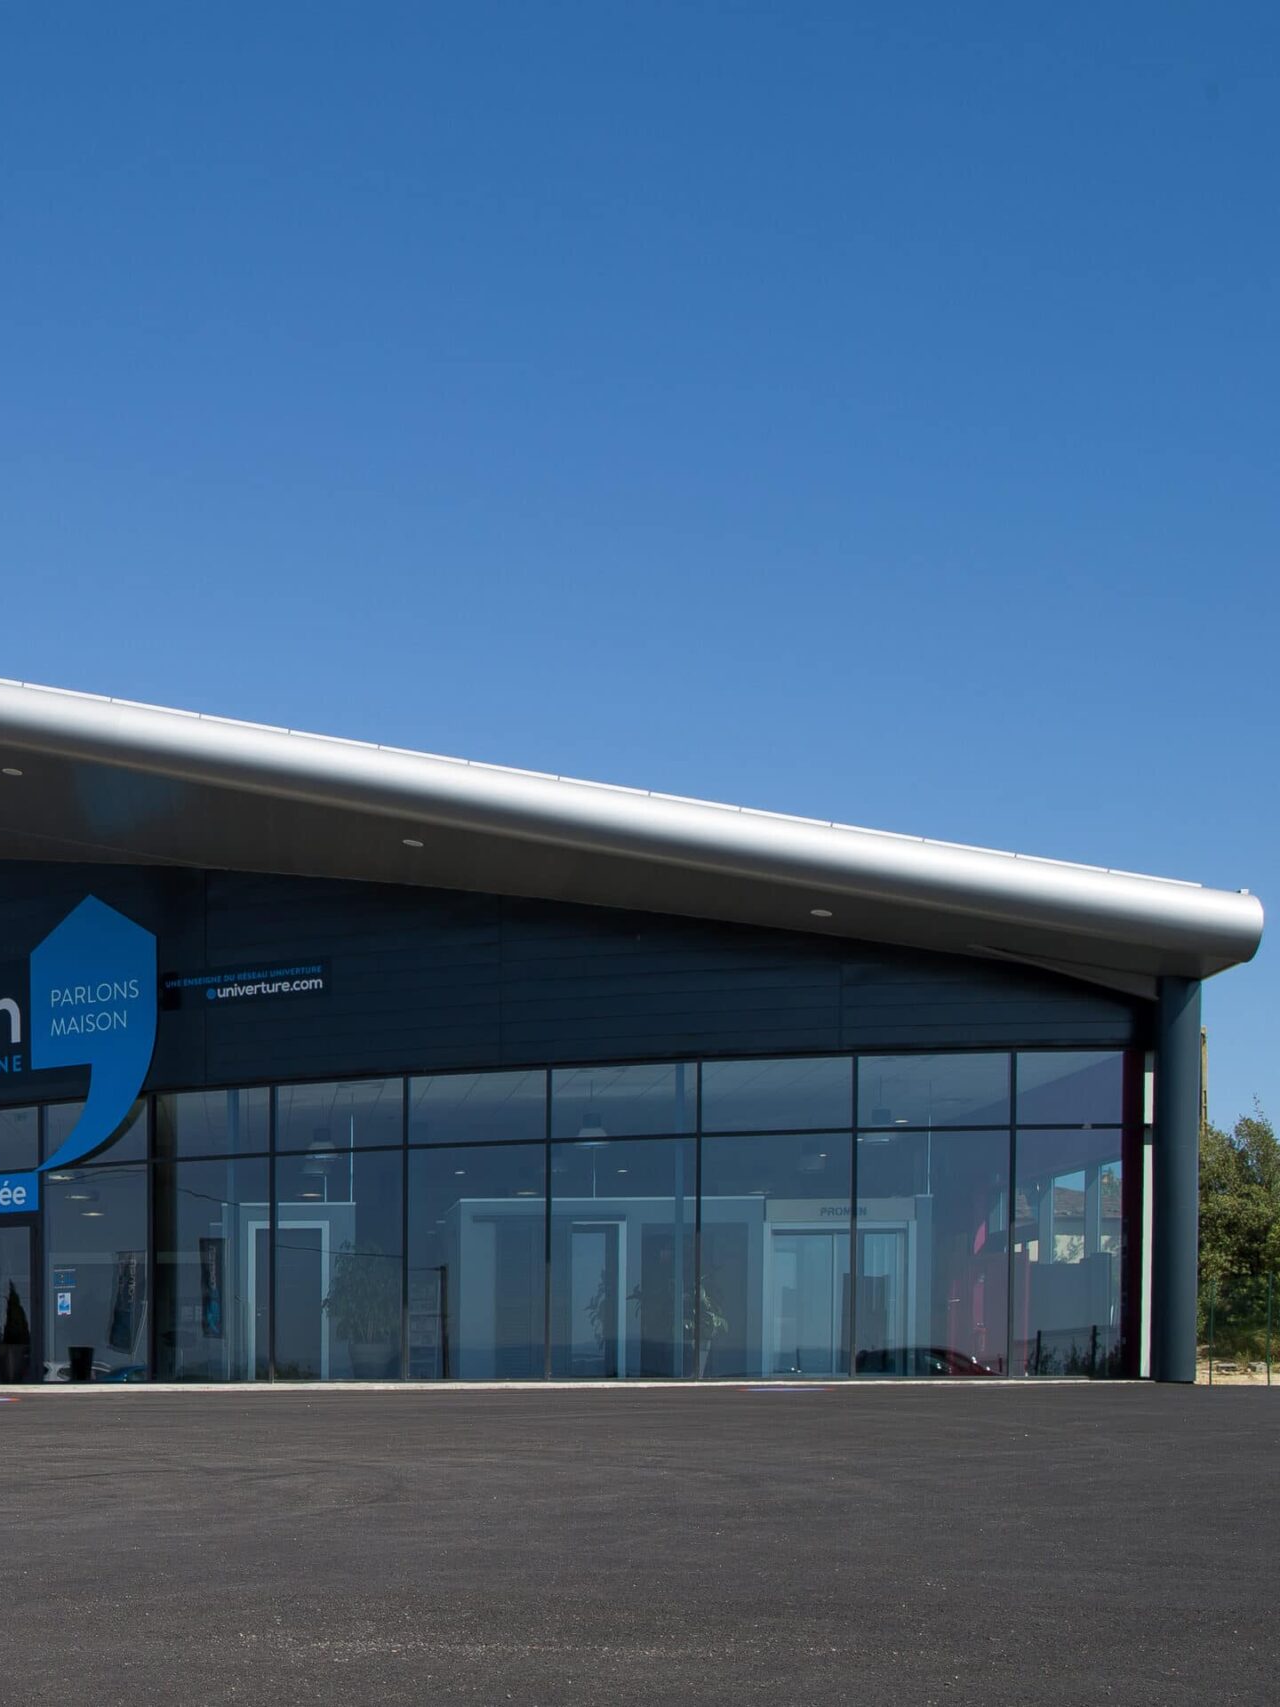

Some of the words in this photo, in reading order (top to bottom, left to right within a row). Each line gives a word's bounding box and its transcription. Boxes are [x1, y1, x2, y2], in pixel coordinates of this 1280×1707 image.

[165, 979, 182, 988] UNE
[224, 973, 236, 983] DU
[270, 965, 323, 978] UNIVERTURE
[216, 978, 324, 999] univerture.com
[51, 979, 139, 1008] PARLONS
[50, 1010, 127, 1037] MAISON
